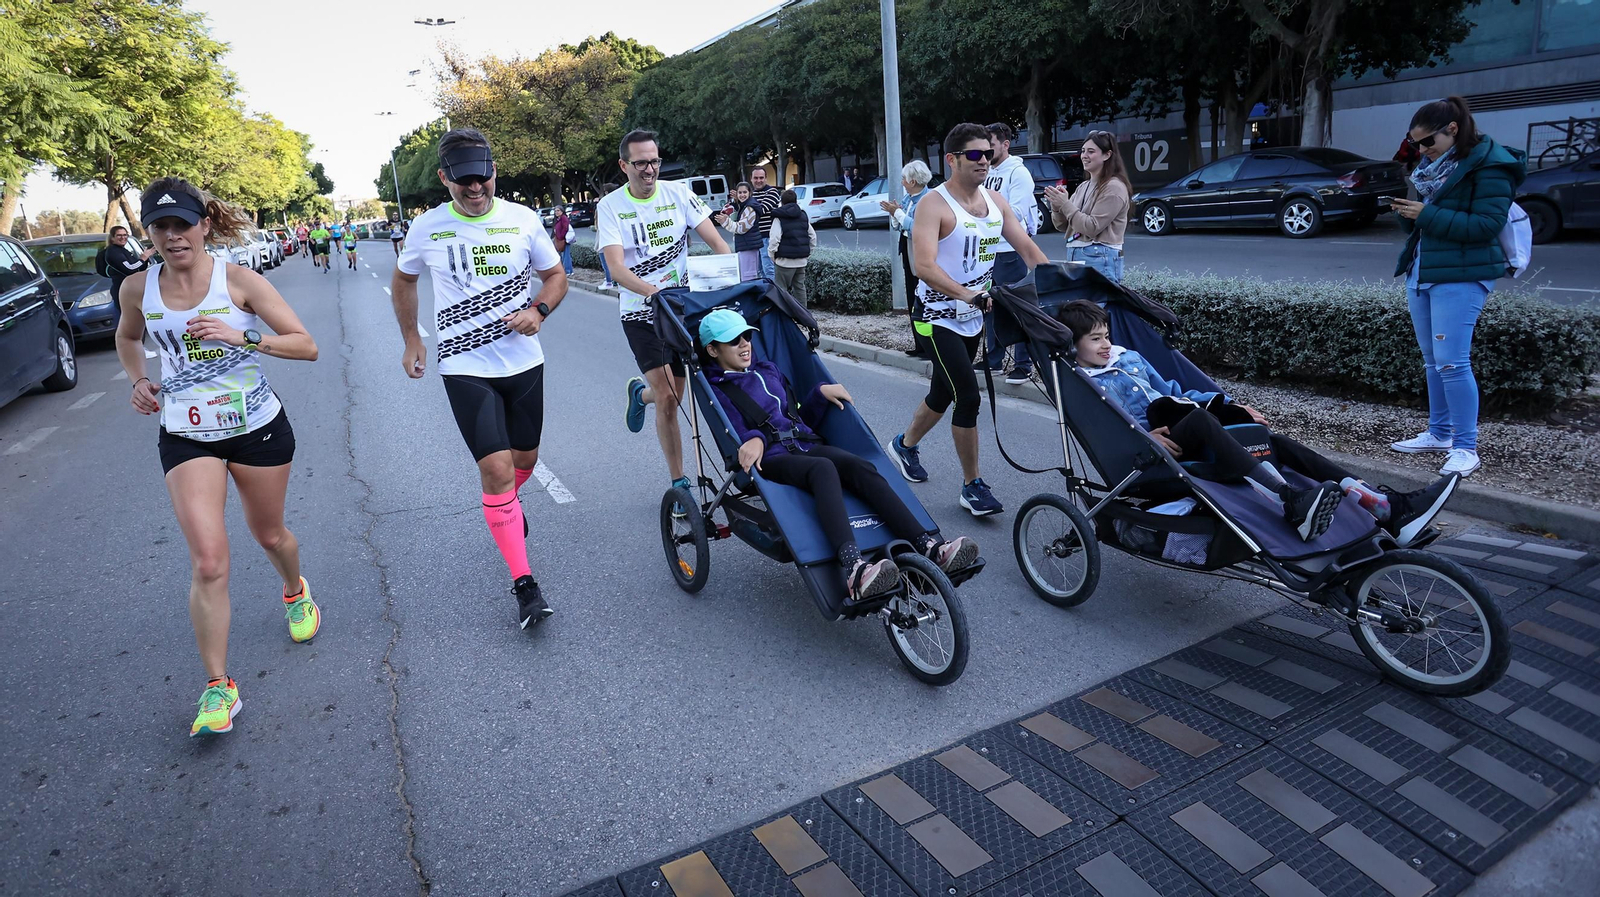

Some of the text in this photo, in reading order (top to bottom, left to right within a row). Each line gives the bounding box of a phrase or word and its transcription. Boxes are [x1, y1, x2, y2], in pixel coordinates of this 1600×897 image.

[1134, 140, 1169, 172] 02
[647, 219, 673, 231] CARROS
[648, 231, 659, 240] DE
[979, 236, 1000, 246] CARRO
[650, 235, 674, 248] FUEGO
[472, 244, 511, 255] CARROS
[979, 246, 987, 254] DE
[473, 256, 487, 266] DE
[979, 253, 995, 262] FUEGO
[475, 265, 508, 277] FUEGO
[185, 341, 201, 352] DE
[188, 348, 224, 362] FUEGO
[188, 405, 202, 426] 6
